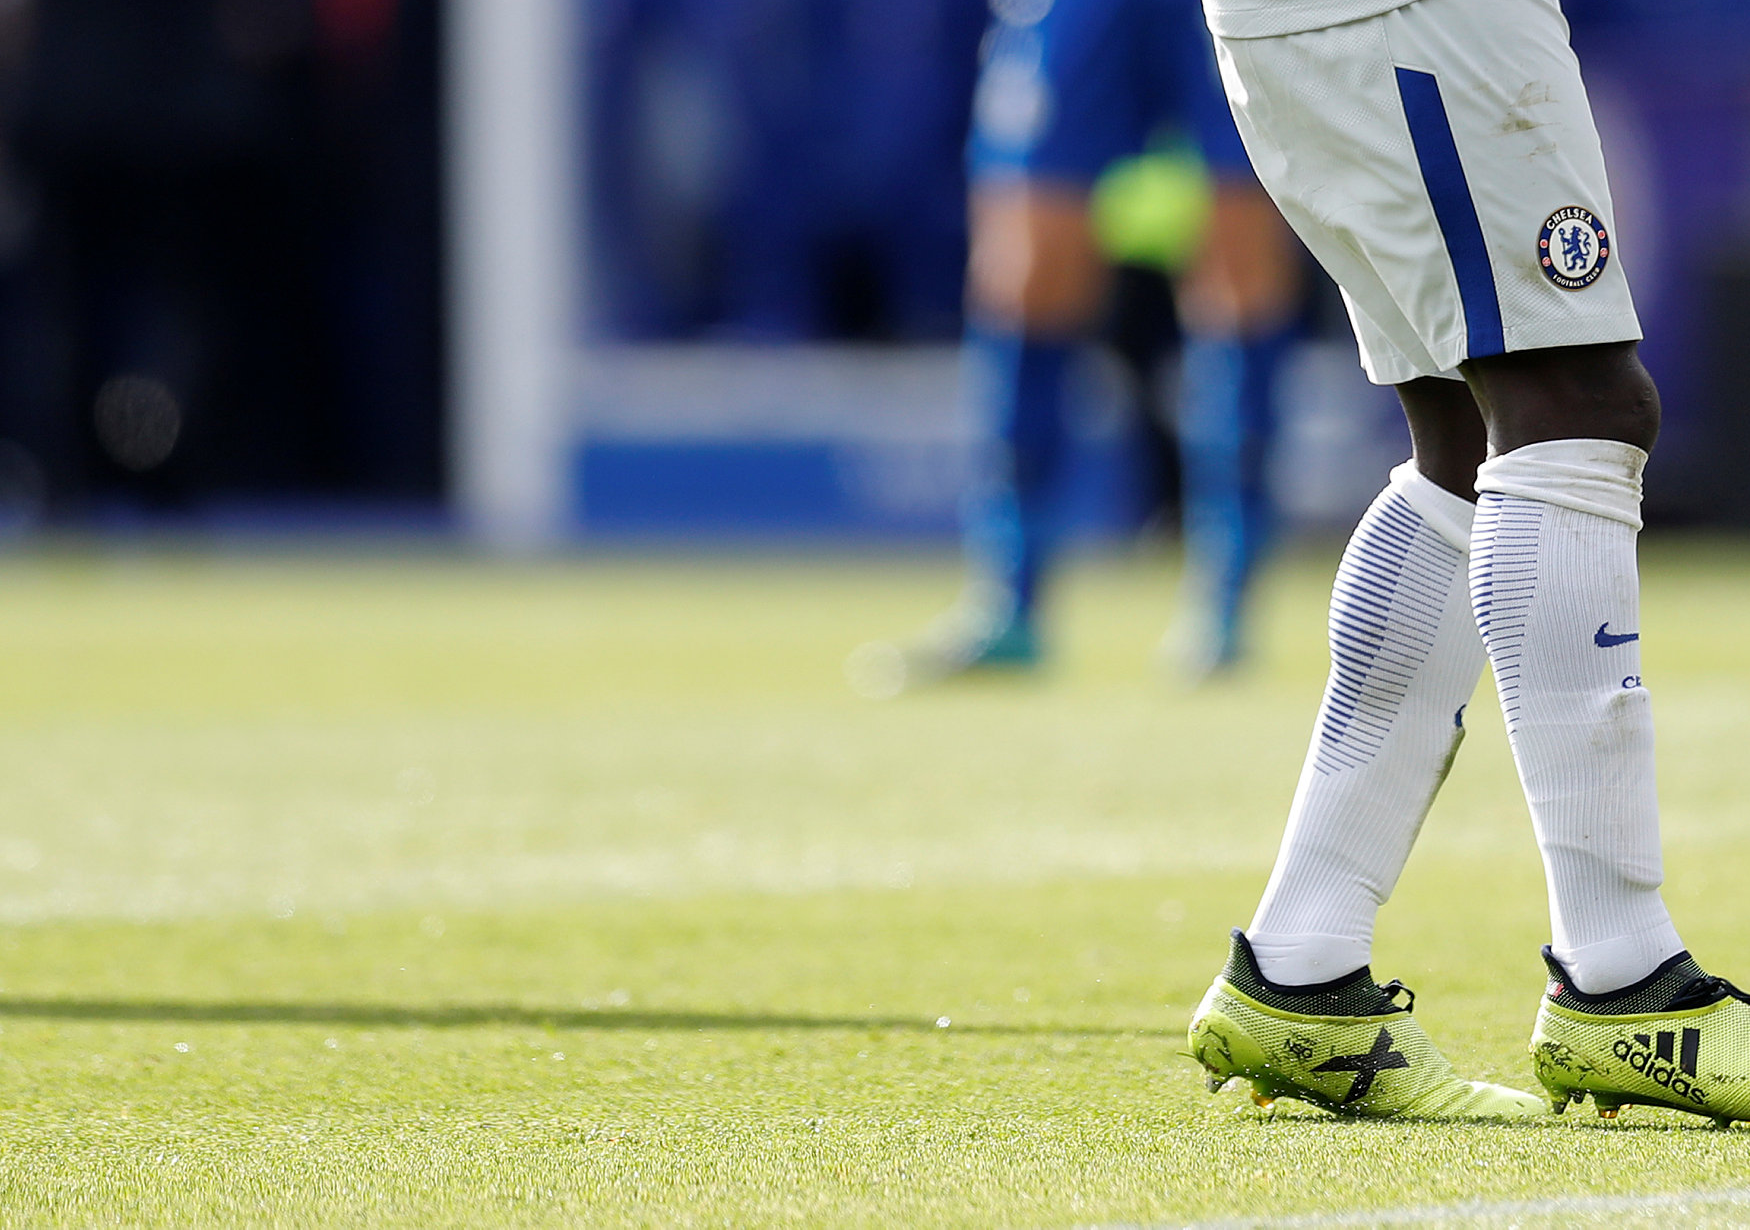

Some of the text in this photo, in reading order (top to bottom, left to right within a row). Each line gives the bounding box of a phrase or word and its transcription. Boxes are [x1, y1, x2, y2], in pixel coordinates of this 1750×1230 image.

[1546, 208, 1593, 230] CHELSEA
[1553, 267, 1600, 287] FOOTBALL CLUB
[1613, 1040, 1709, 1105] adidas
